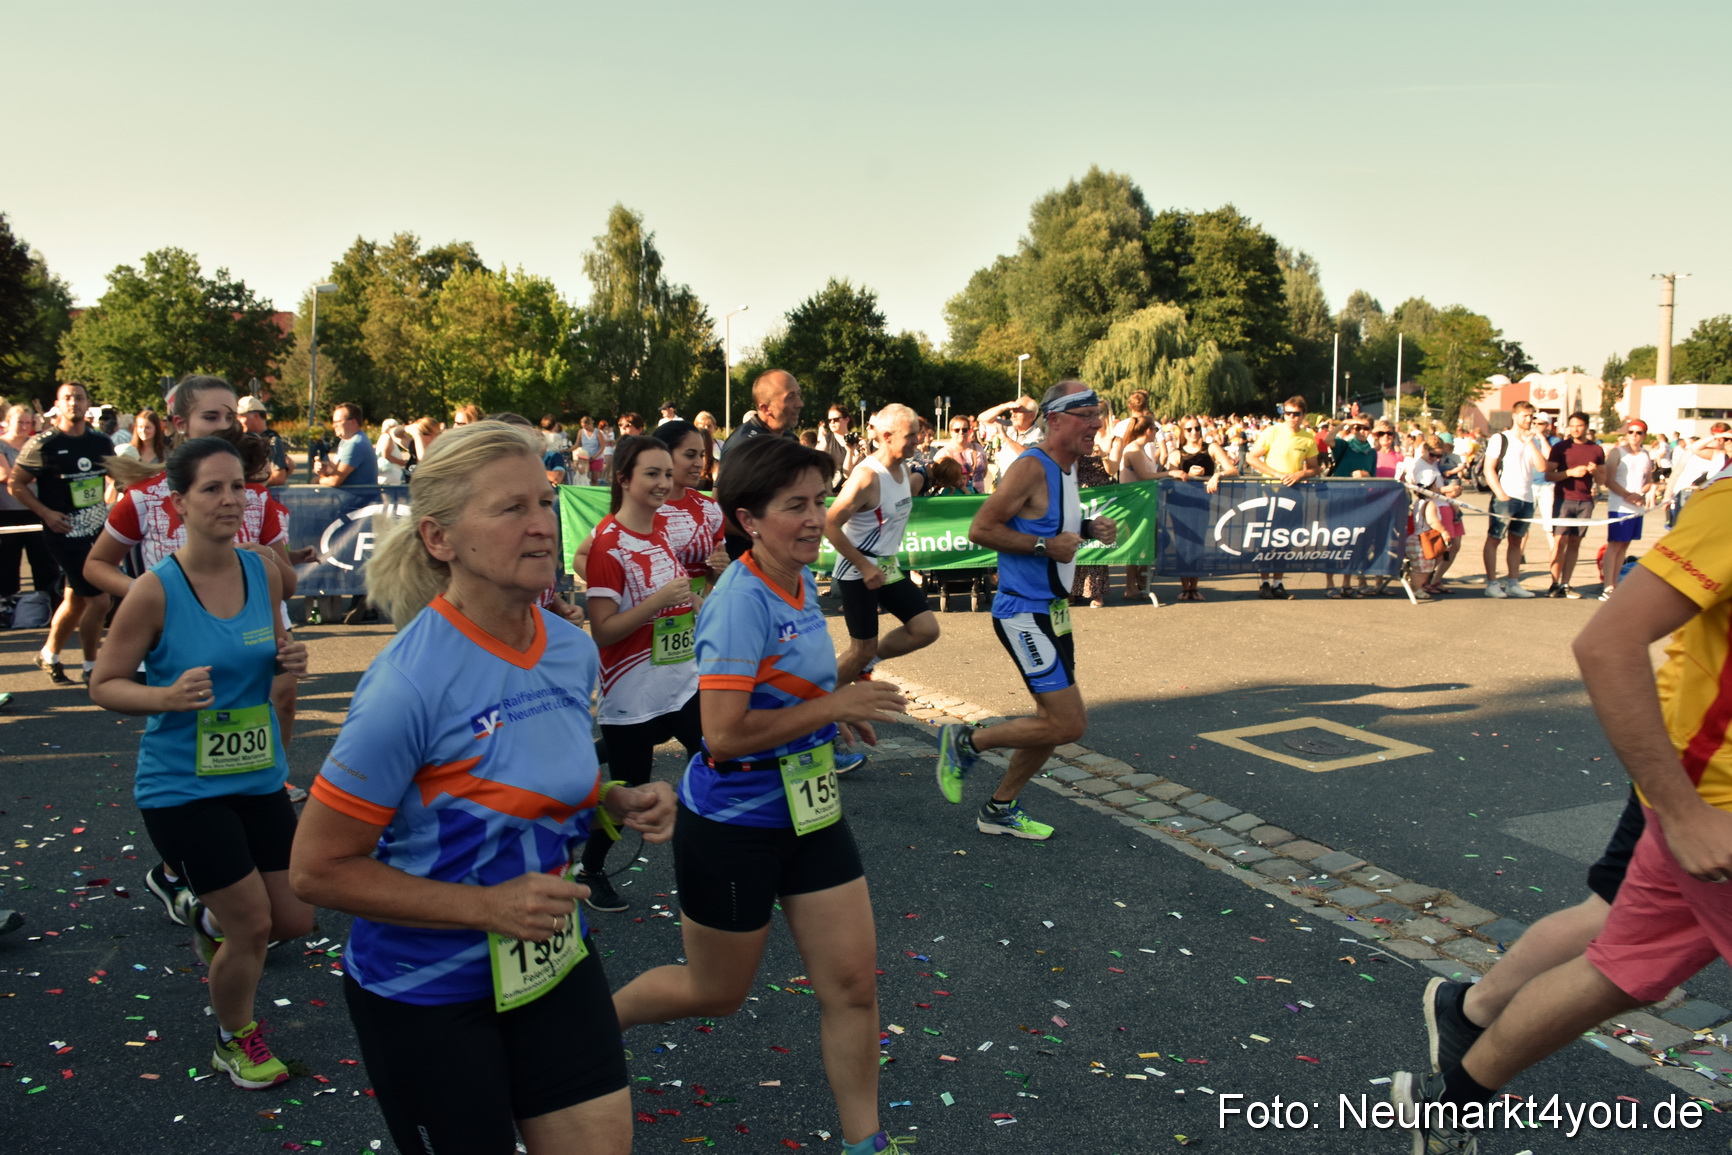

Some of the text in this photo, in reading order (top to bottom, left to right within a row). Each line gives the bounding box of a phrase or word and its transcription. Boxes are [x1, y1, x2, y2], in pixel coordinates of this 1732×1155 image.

[83, 488, 96, 499] 82
[1242, 521, 1366, 549] Fischer
[1252, 550, 1353, 562] AUTOMOBILE
[1021, 630, 1044, 666] HUBER
[208, 728, 267, 757] 2030
